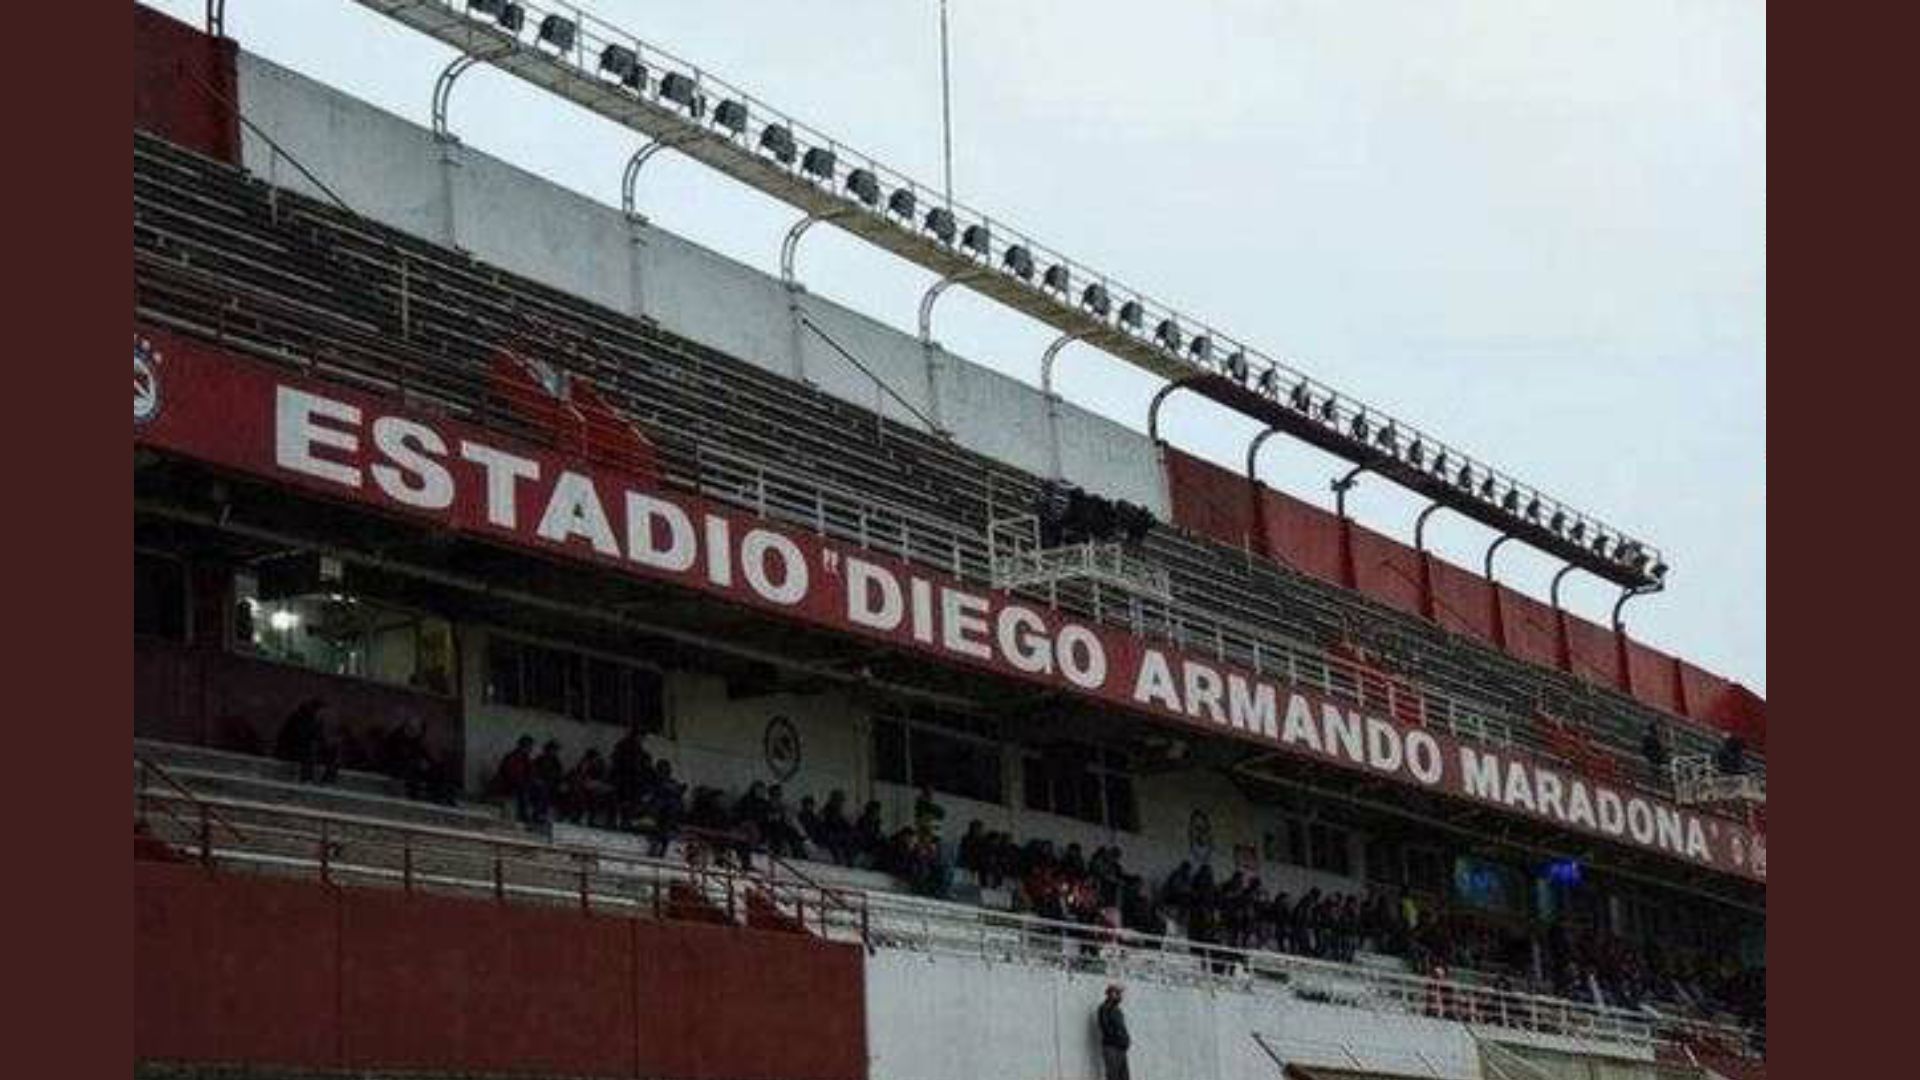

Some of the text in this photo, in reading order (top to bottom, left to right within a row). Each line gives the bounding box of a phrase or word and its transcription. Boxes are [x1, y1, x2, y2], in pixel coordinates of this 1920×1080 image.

[275, 385, 809, 605] ESTADIO
[823, 549, 1107, 688] "DIEGO
[1133, 651, 1443, 784] ARMANDO
